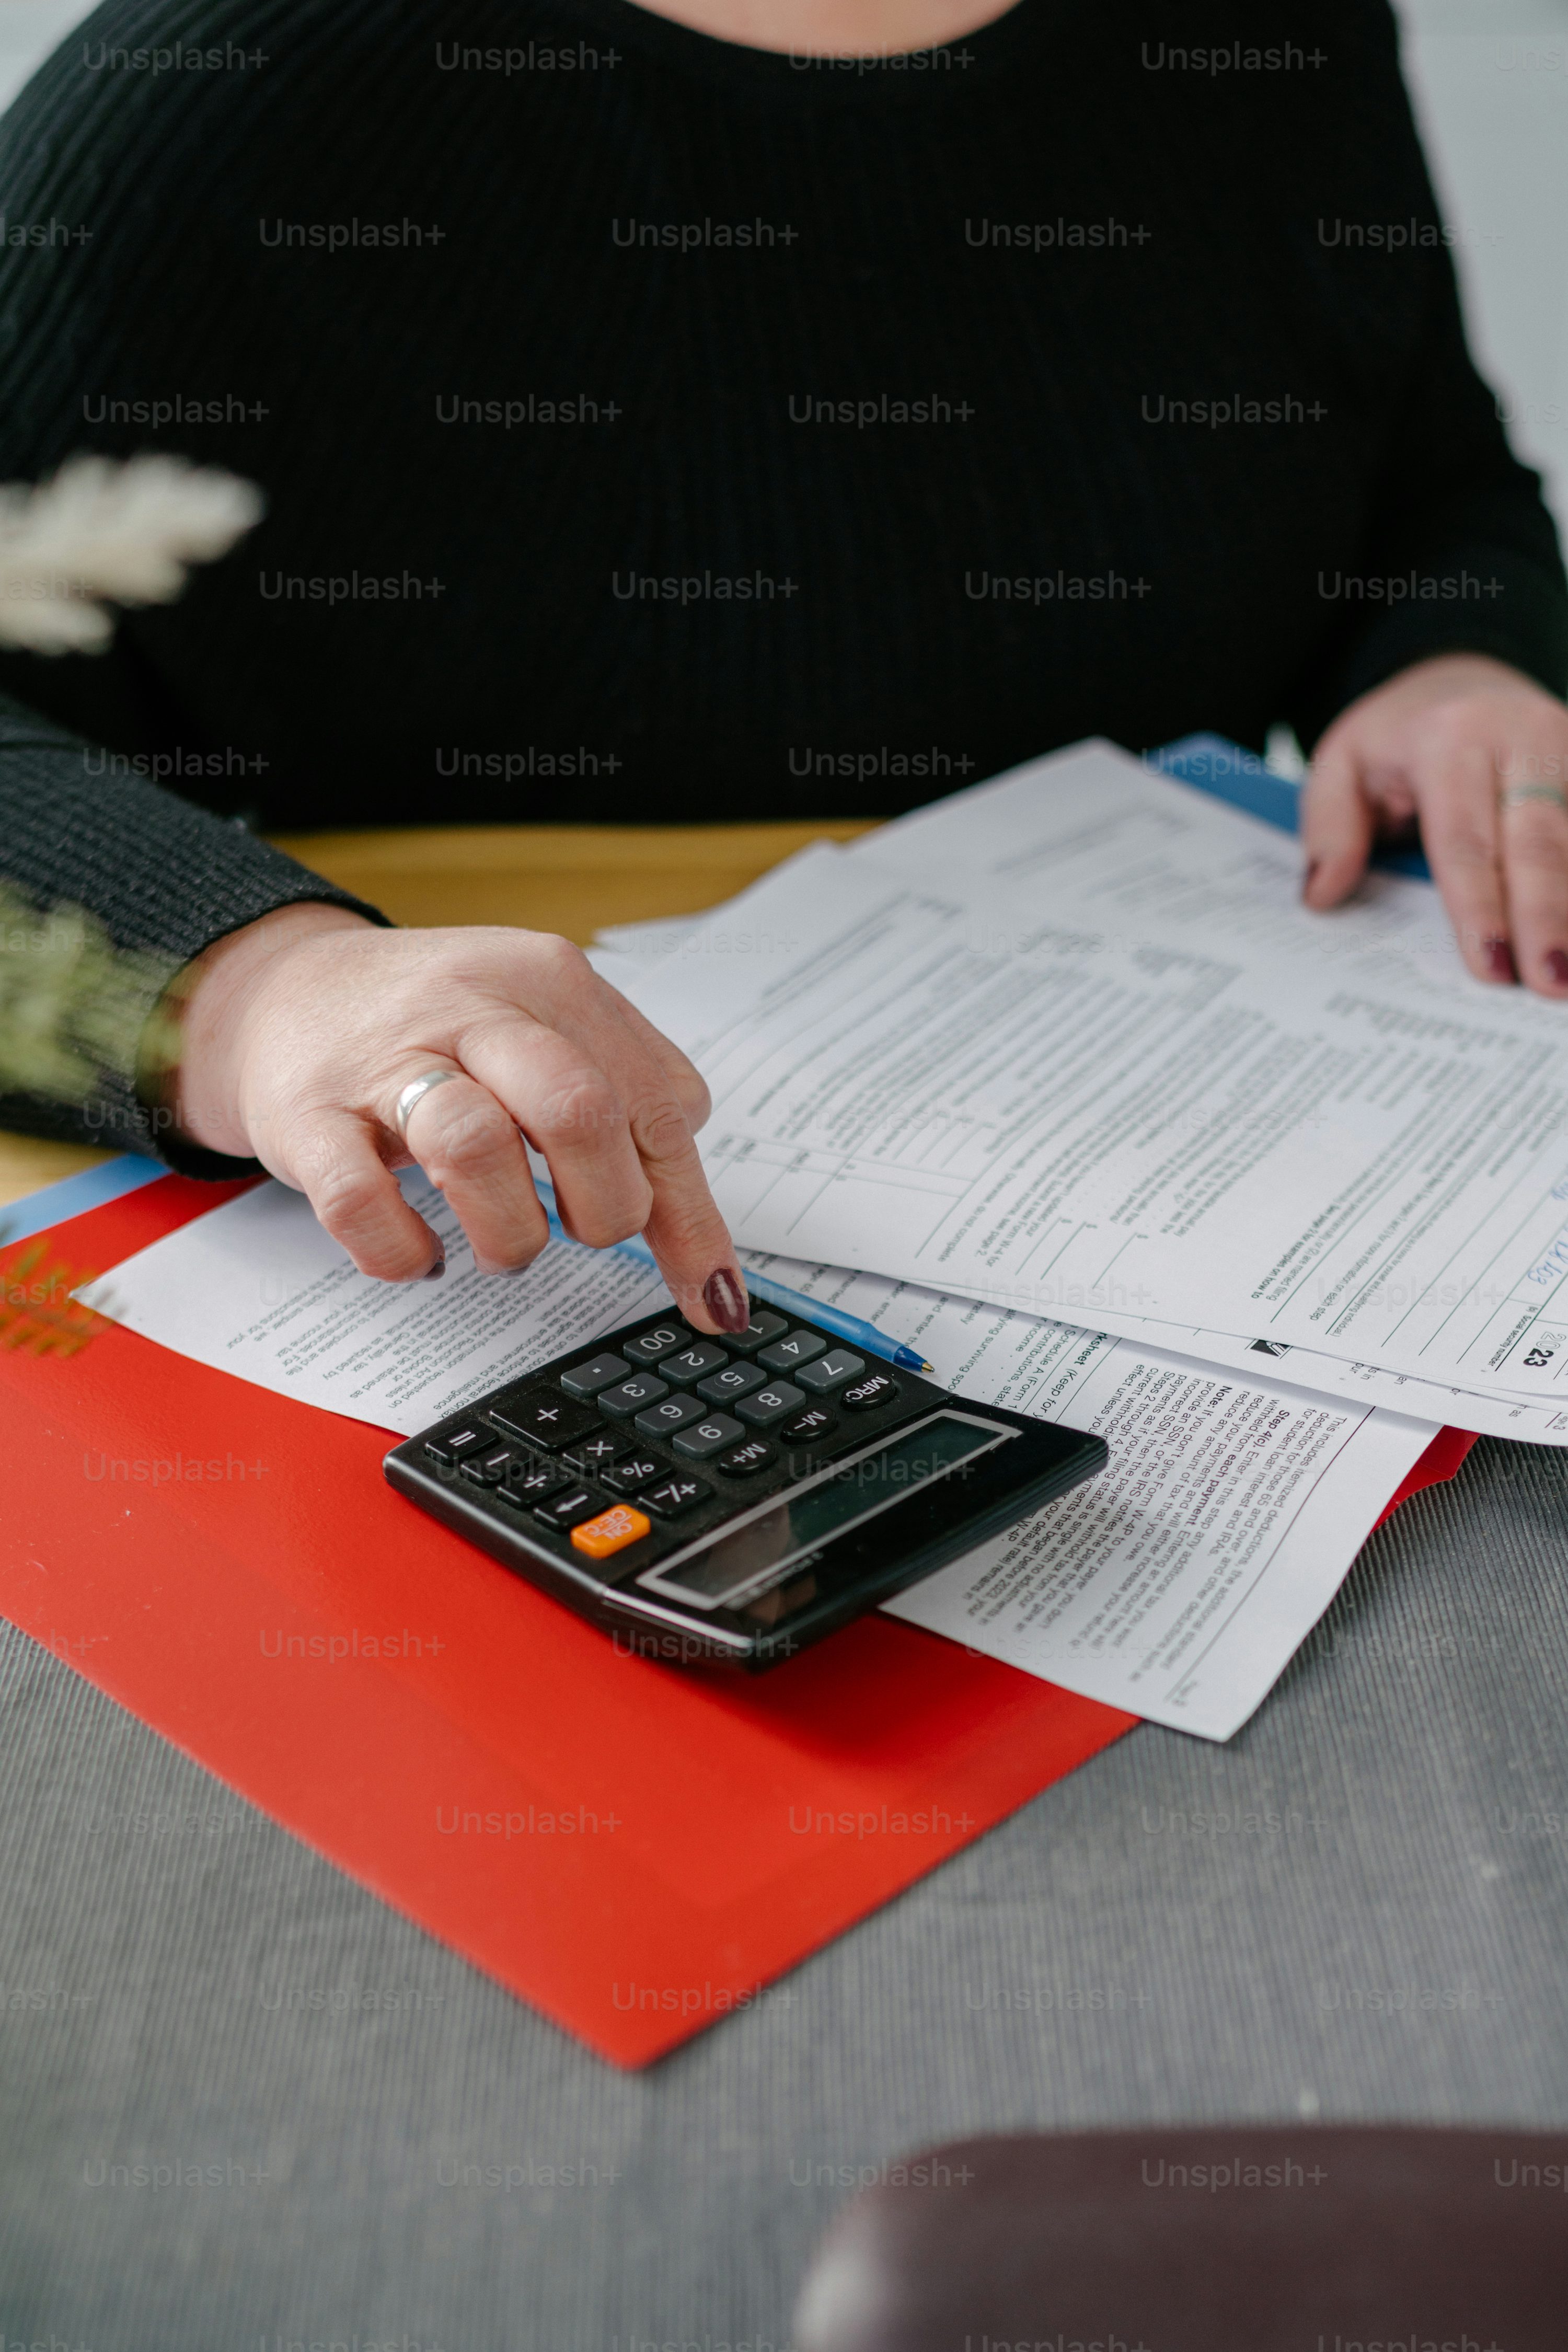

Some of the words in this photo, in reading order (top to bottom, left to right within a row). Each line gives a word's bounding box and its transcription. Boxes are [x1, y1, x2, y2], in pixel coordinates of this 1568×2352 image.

[1259, 1276, 1275, 1292] how
[1266, 1286, 1287, 1301] filing
[1322, 1293, 1338, 1307] each
[914, 1314, 934, 1335] enter
[1310, 1307, 1326, 1321] step
[1516, 1316, 1531, 1330] Social
[640, 1330, 676, 1350] 00
[748, 1325, 764, 1334] 1
[1015, 1322, 1046, 1352] income
[1500, 1330, 1519, 1348] security
[781, 1342, 800, 1354] 4
[959, 1336, 993, 1373] surviving
[1007, 1329, 1056, 1382] contributions,
[1040, 1329, 1076, 1366] Schedule
[1074, 1332, 1109, 1366] rksheet
[1488, 1348, 1505, 1366] number
[1523, 1331, 1566, 1367] 2023
[401, 1355, 432, 1375] Books
[679, 1352, 704, 1366] 2
[822, 1361, 844, 1376] 7
[481, 1364, 499, 1378] and
[721, 1372, 745, 1386] 5
[1122, 1364, 1145, 1387] effect
[385, 1378, 414, 1399] unless
[406, 1370, 445, 1400] requested
[622, 1384, 645, 1397] 3
[846, 1376, 889, 1400] MRC
[1012, 1376, 1039, 1401] (Form
[1051, 1369, 1078, 1397] (Keep
[1131, 1368, 1159, 1396] current
[1150, 1371, 1175, 1394] Steps
[388, 1399, 402, 1409] on
[433, 1377, 478, 1410] intelligence
[758, 1393, 782, 1406] 8
[1101, 1388, 1126, 1414] unless
[1152, 1374, 1187, 1413] payments
[1169, 1378, 1205, 1413] incorrect
[1187, 1381, 1216, 1411] provide
[1207, 1386, 1233, 1408] Note:
[1224, 1390, 1251, 1418] reduce
[660, 1405, 683, 1418] 6
[1040, 1398, 1056, 1413] for
[1239, 1394, 1265, 1422] reduce
[1248, 1399, 1280, 1433] withheld
[1301, 1408, 1317, 1420] for
[1119, 1403, 1150, 1436] through
[1150, 1414, 1175, 1435] SSN,
[1178, 1413, 1191, 1424] an
[1189, 1416, 1206, 1433] you
[1210, 1419, 1228, 1435] any
[1268, 1410, 1290, 1429] Step
[1326, 1417, 1347, 1432] This
[698, 1425, 722, 1439] 9
[1159, 1425, 1184, 1447] SSN,
[1224, 1422, 1243, 1443] your
[1253, 1431, 1272, 1448] 4(c).
[1276, 1420, 1305, 1450] student
[1294, 1412, 1330, 1450] deduction
[1123, 1434, 1142, 1457] your
[1136, 1439, 1158, 1459] then
[1171, 1434, 1193, 1458] don't
[1232, 1433, 1255, 1452] from
[1299, 1433, 1333, 1467] includes
[1186, 1436, 1215, 1471] amount
[1236, 1450, 1260, 1475] Enter
[1262, 1451, 1284, 1470] loan
[1285, 1452, 1301, 1465] for
[621, 1462, 654, 1478] %
[1104, 1458, 1129, 1480] filing
[1125, 1461, 1143, 1477] the
[1142, 1462, 1159, 1477] the
[1157, 1459, 1175, 1479] give
[1192, 1443, 1228, 1488] payments
[1215, 1454, 1237, 1478] each
[1129, 1479, 1148, 1497] IRS
[1266, 1466, 1291, 1491] those
[1273, 1468, 1307, 1508] itemized
[1085, 1481, 1110, 1510] status
[1106, 1478, 1129, 1506] payer
[1139, 1481, 1164, 1506] Form
[1179, 1490, 1196, 1510] and
[1215, 1488, 1235, 1506] this
[1238, 1472, 1270, 1508] interest
[1154, 1502, 1174, 1521] that
[1184, 1479, 1220, 1526] payment.
[1104, 1498, 1133, 1532] notifies
[1122, 1509, 1146, 1536] W-4P
[605, 1523, 633, 1541] ON
